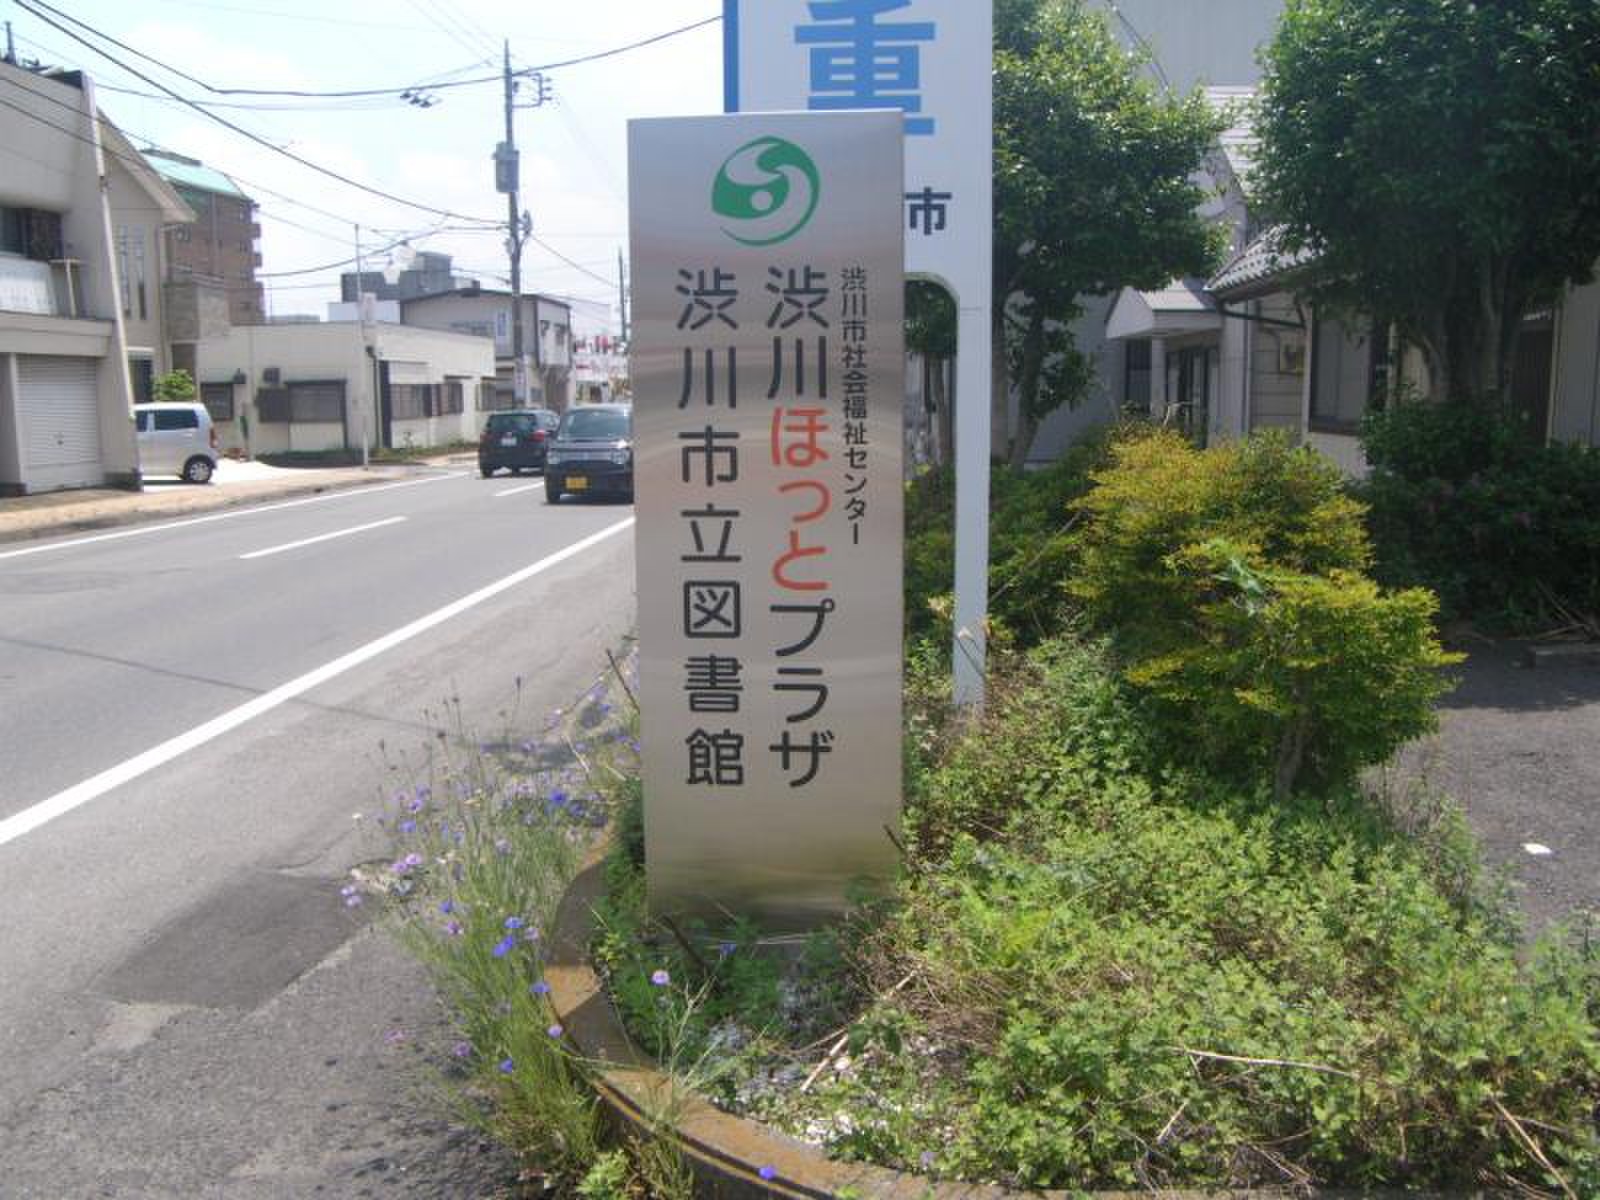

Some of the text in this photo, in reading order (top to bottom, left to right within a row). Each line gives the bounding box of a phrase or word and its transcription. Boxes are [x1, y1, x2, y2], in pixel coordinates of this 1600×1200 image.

[793, 0, 936, 136] 重
[903, 186, 953, 236] 市
[675, 267, 744, 786] 渋川市立図書館
[764, 265, 836, 788] 渋川ほっとプラザ
[840, 266, 869, 545] 渋川市社会福祉センター
